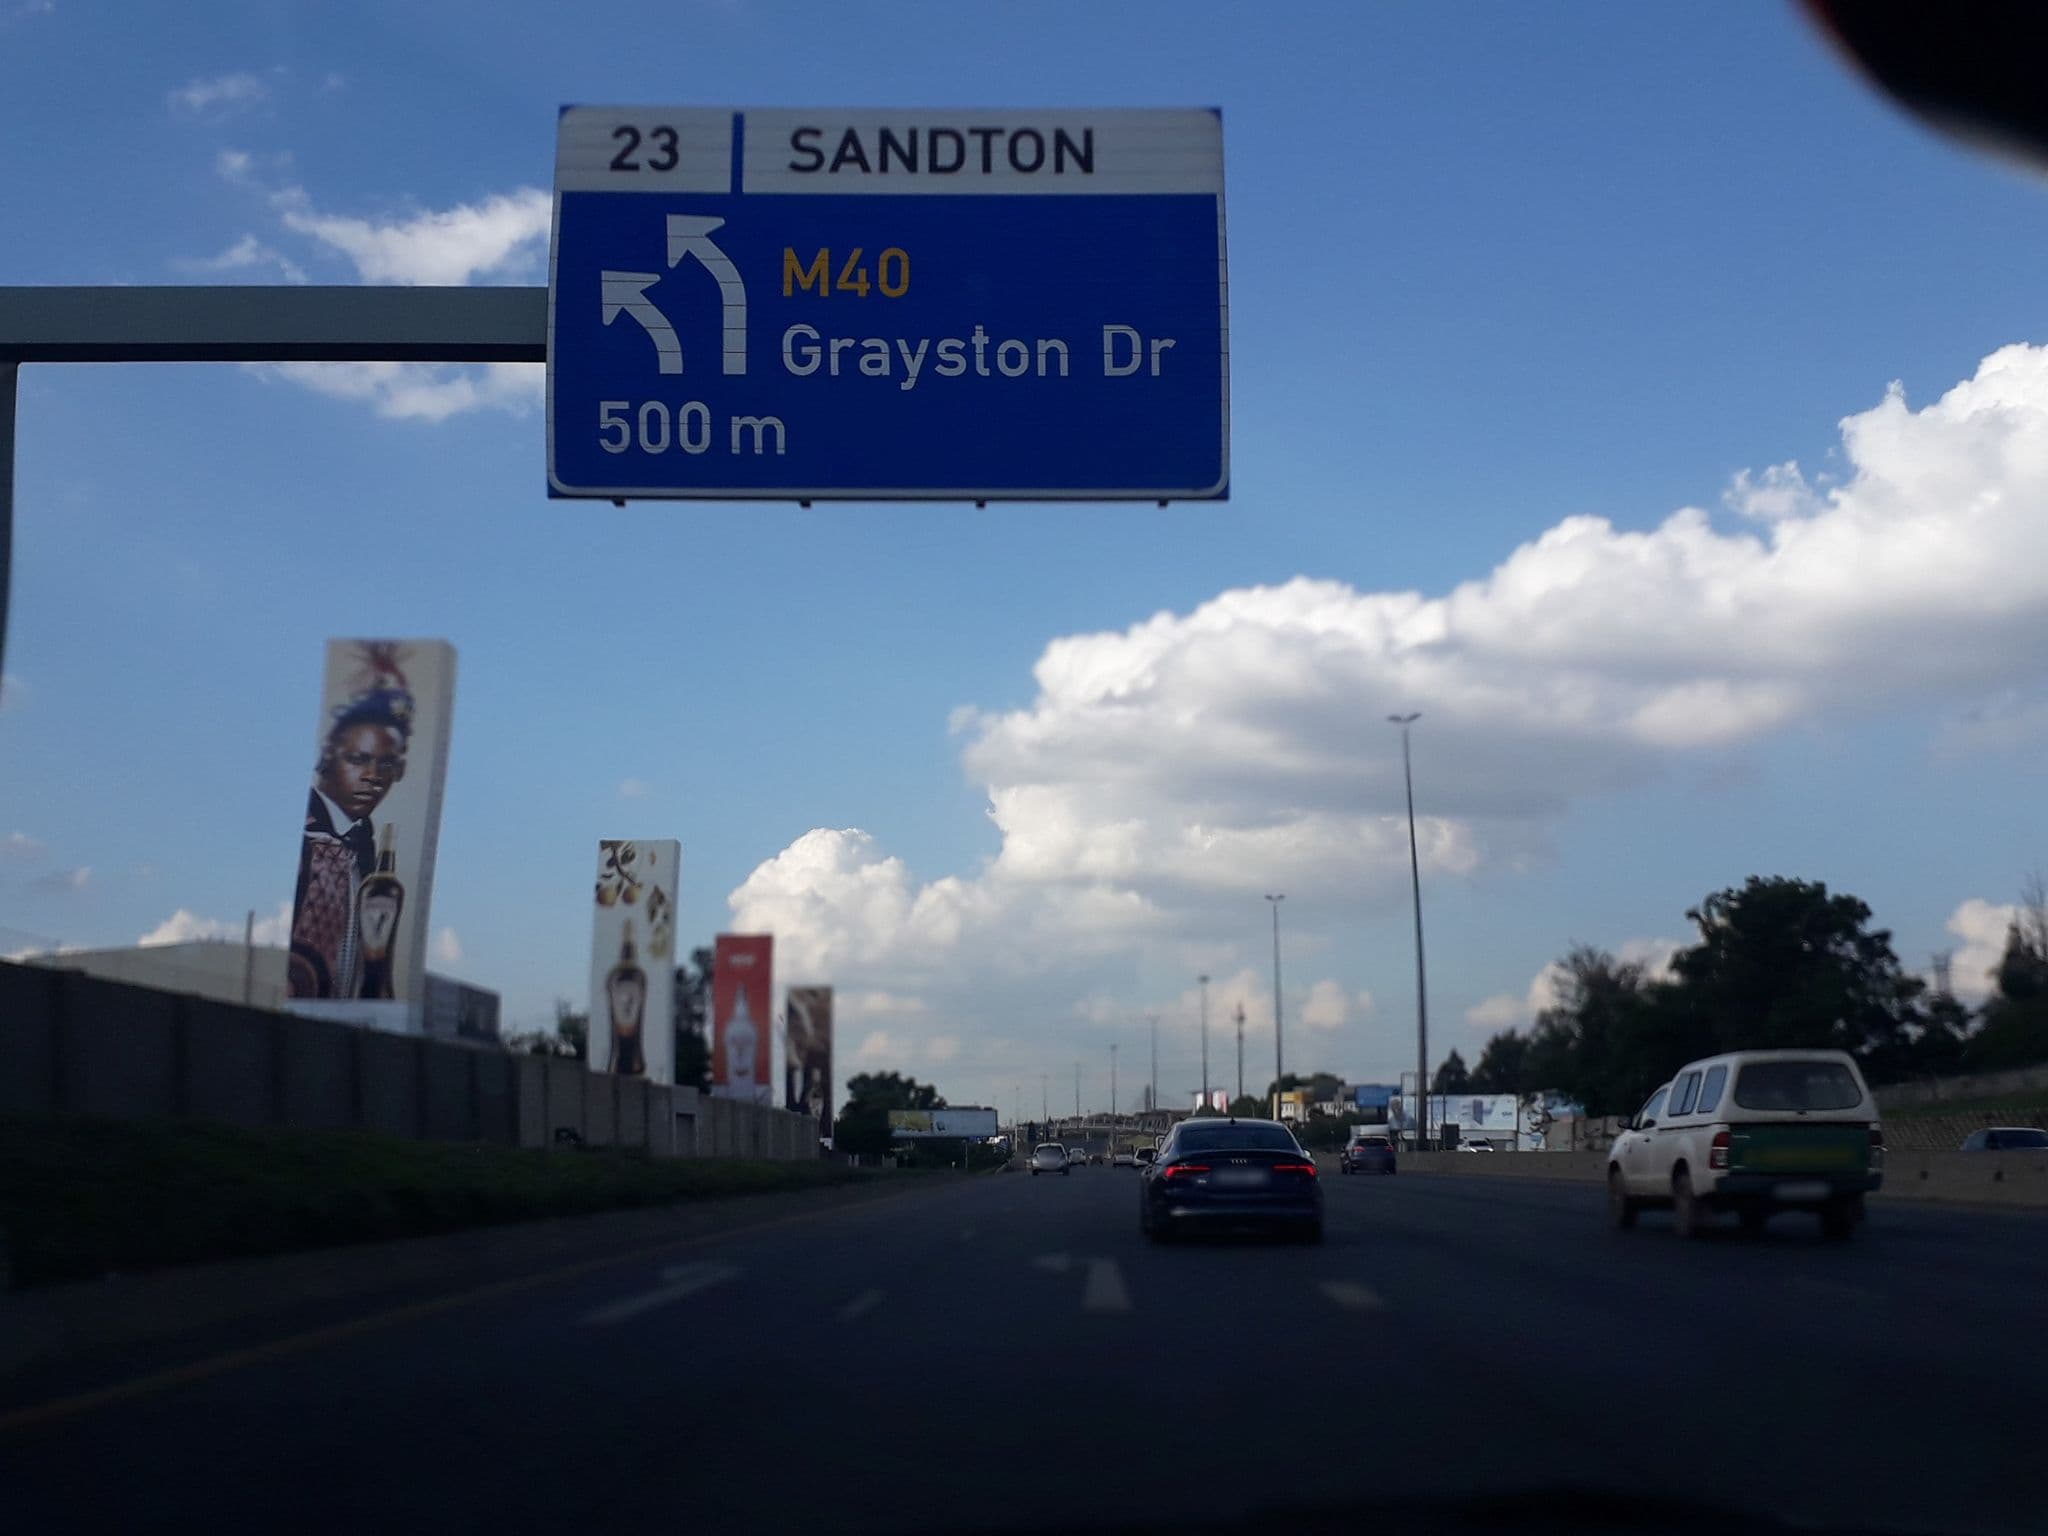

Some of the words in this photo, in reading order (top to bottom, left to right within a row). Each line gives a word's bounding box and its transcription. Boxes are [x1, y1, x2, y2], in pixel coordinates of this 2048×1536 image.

[609, 125, 679, 172] 23
[788, 127, 1094, 175] SANDTON
[782, 247, 910, 298] M40
[782, 323, 1069, 391] Grayston
[1103, 324, 1177, 377] Dr
[599, 400, 711, 454] 500
[731, 415, 786, 455] m
